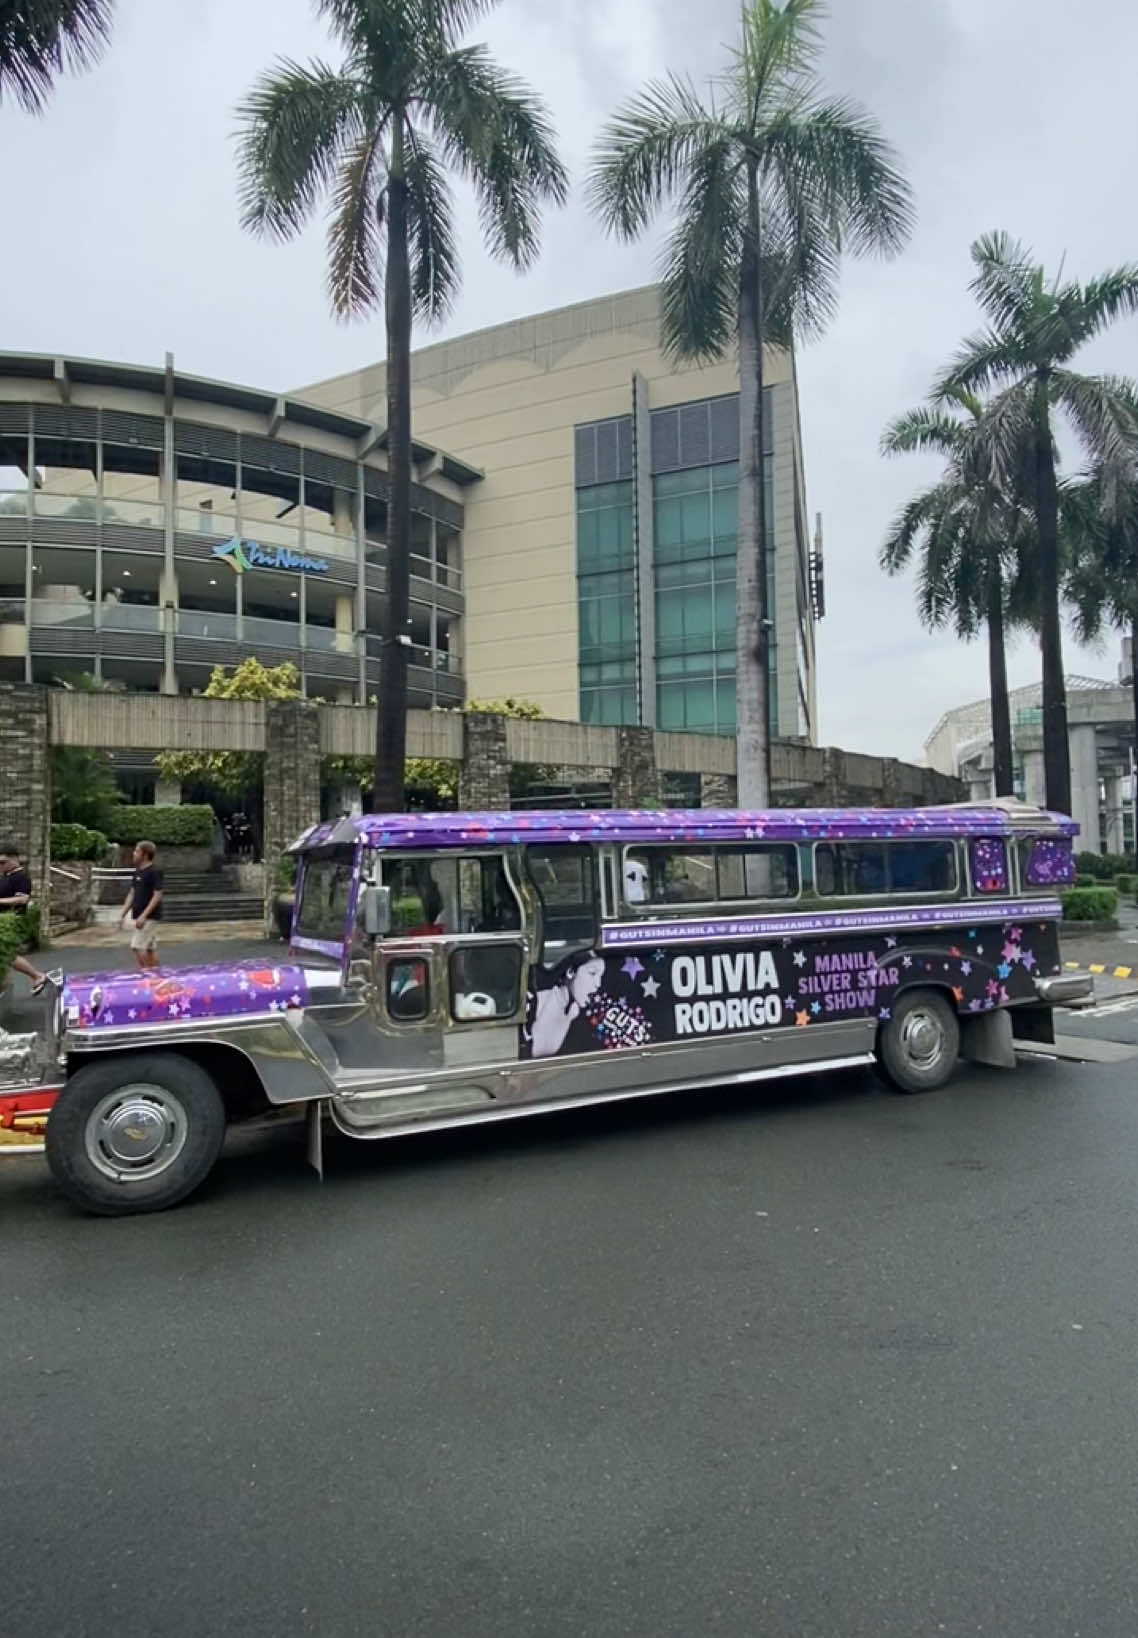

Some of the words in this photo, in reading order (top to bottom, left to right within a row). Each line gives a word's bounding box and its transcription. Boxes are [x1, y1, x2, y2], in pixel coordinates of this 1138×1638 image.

[609, 926, 715, 940] #GUTSINMANILA
[729, 920, 822, 933] #GUTSINMANILA
[834, 913, 918, 926] #GUTSINMANILA
[671, 951, 779, 997] OLIVIA
[815, 951, 877, 973] MANILA
[798, 973, 851, 994] SILVER
[858, 967, 899, 988] STAR
[824, 989, 876, 1011] SHOW
[606, 1007, 646, 1042] GUTS
[674, 994, 782, 1034] RODRIGO
